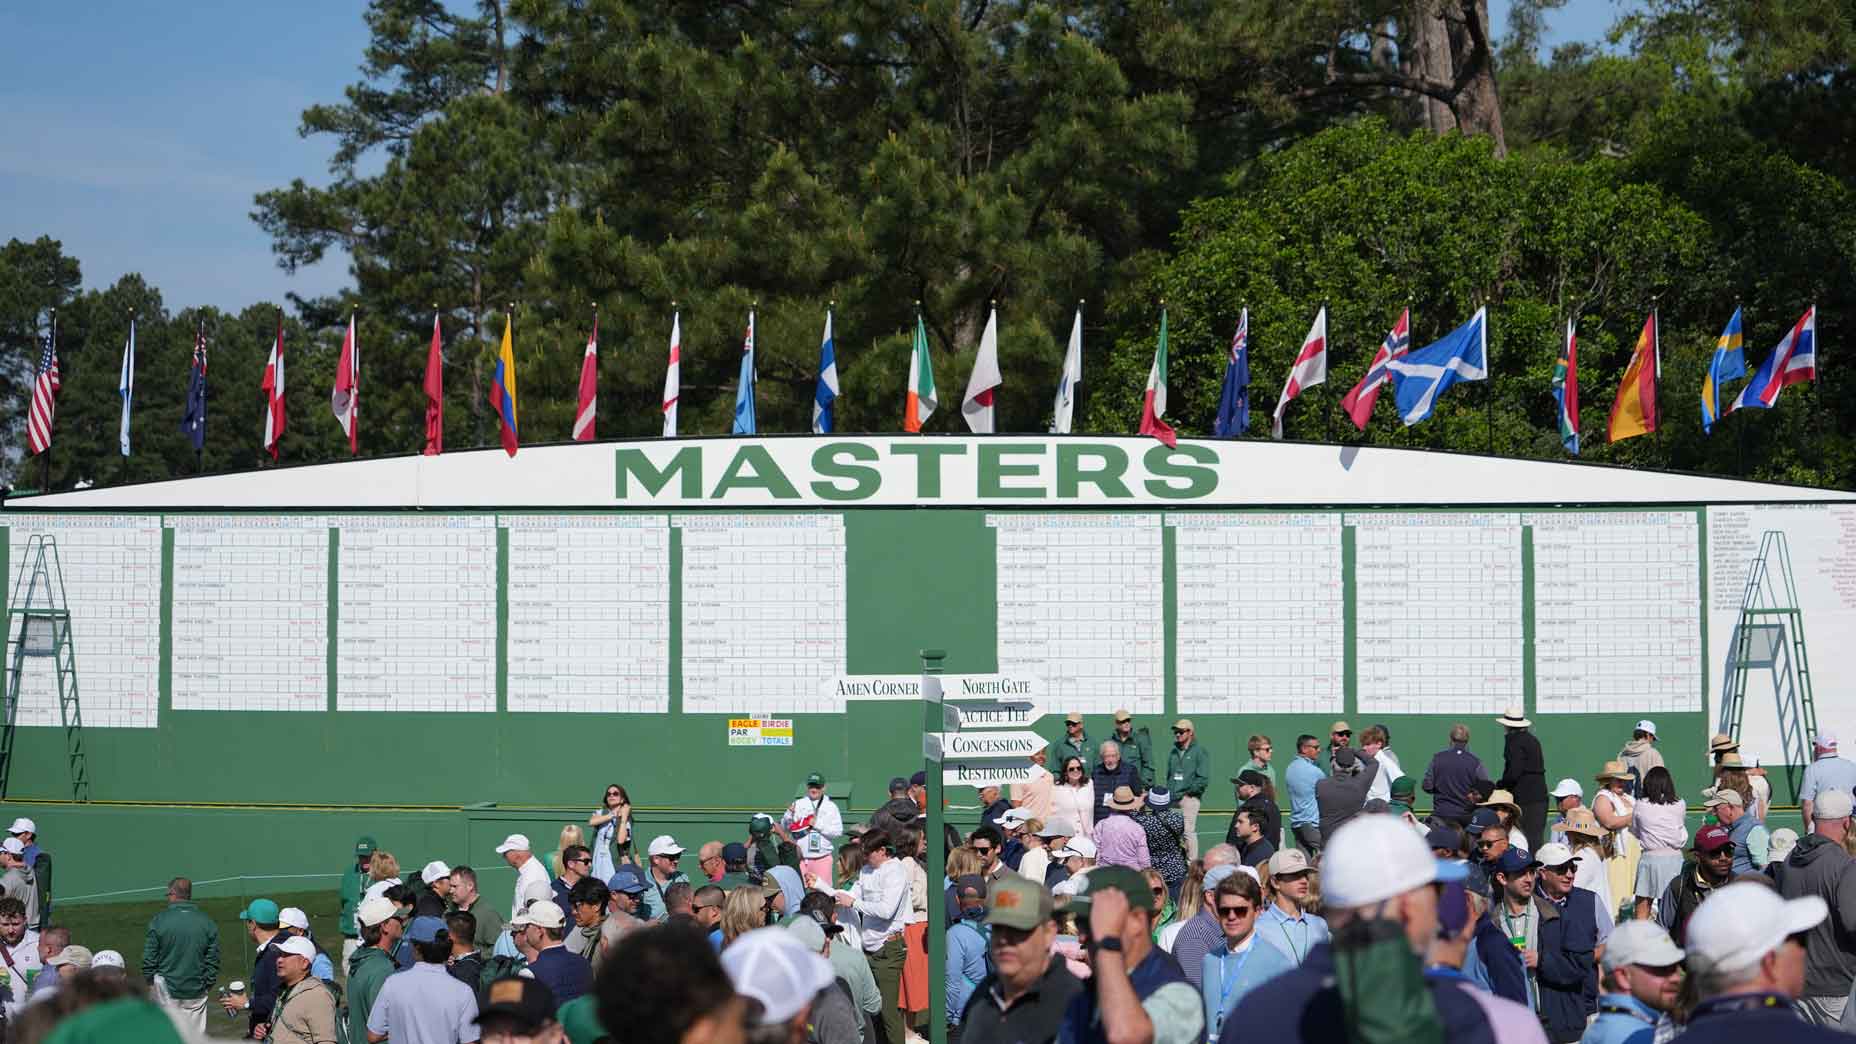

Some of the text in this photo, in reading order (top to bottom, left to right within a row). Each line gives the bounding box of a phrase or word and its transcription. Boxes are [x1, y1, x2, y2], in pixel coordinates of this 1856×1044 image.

[615, 442, 1220, 500] MASTERS
[836, 679, 871, 696] AMEN
[872, 679, 919, 696] CORNER
[962, 678, 1000, 695] NORTH
[1001, 678, 1031, 695] GATE
[960, 705, 1029, 723] ACTICE TEE
[731, 720, 790, 728] EAGLE BIRDIE
[731, 728, 748, 736] PAR
[952, 736, 1033, 753] CONCESSIONS
[957, 764, 1030, 781] RESTROOMS
